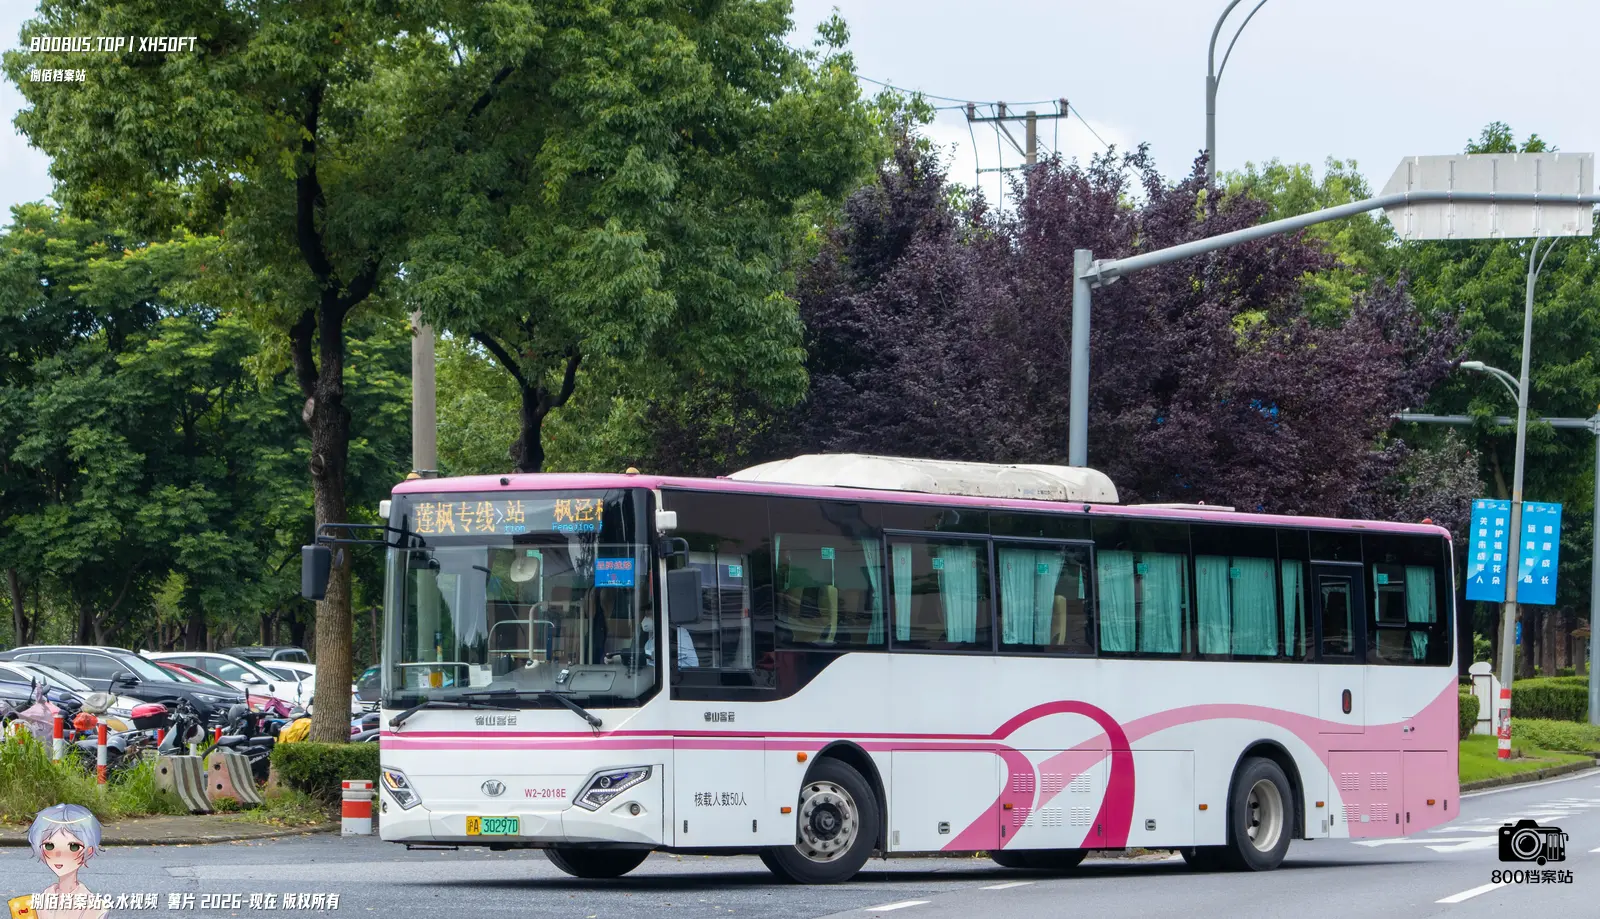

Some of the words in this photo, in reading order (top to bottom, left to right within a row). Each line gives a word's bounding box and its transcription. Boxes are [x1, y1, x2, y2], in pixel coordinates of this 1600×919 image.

[415, 501, 495, 534] 莲枫专线
[524, 787, 567, 799] W2-2018E
[694, 792, 748, 808] 核载人数50人
